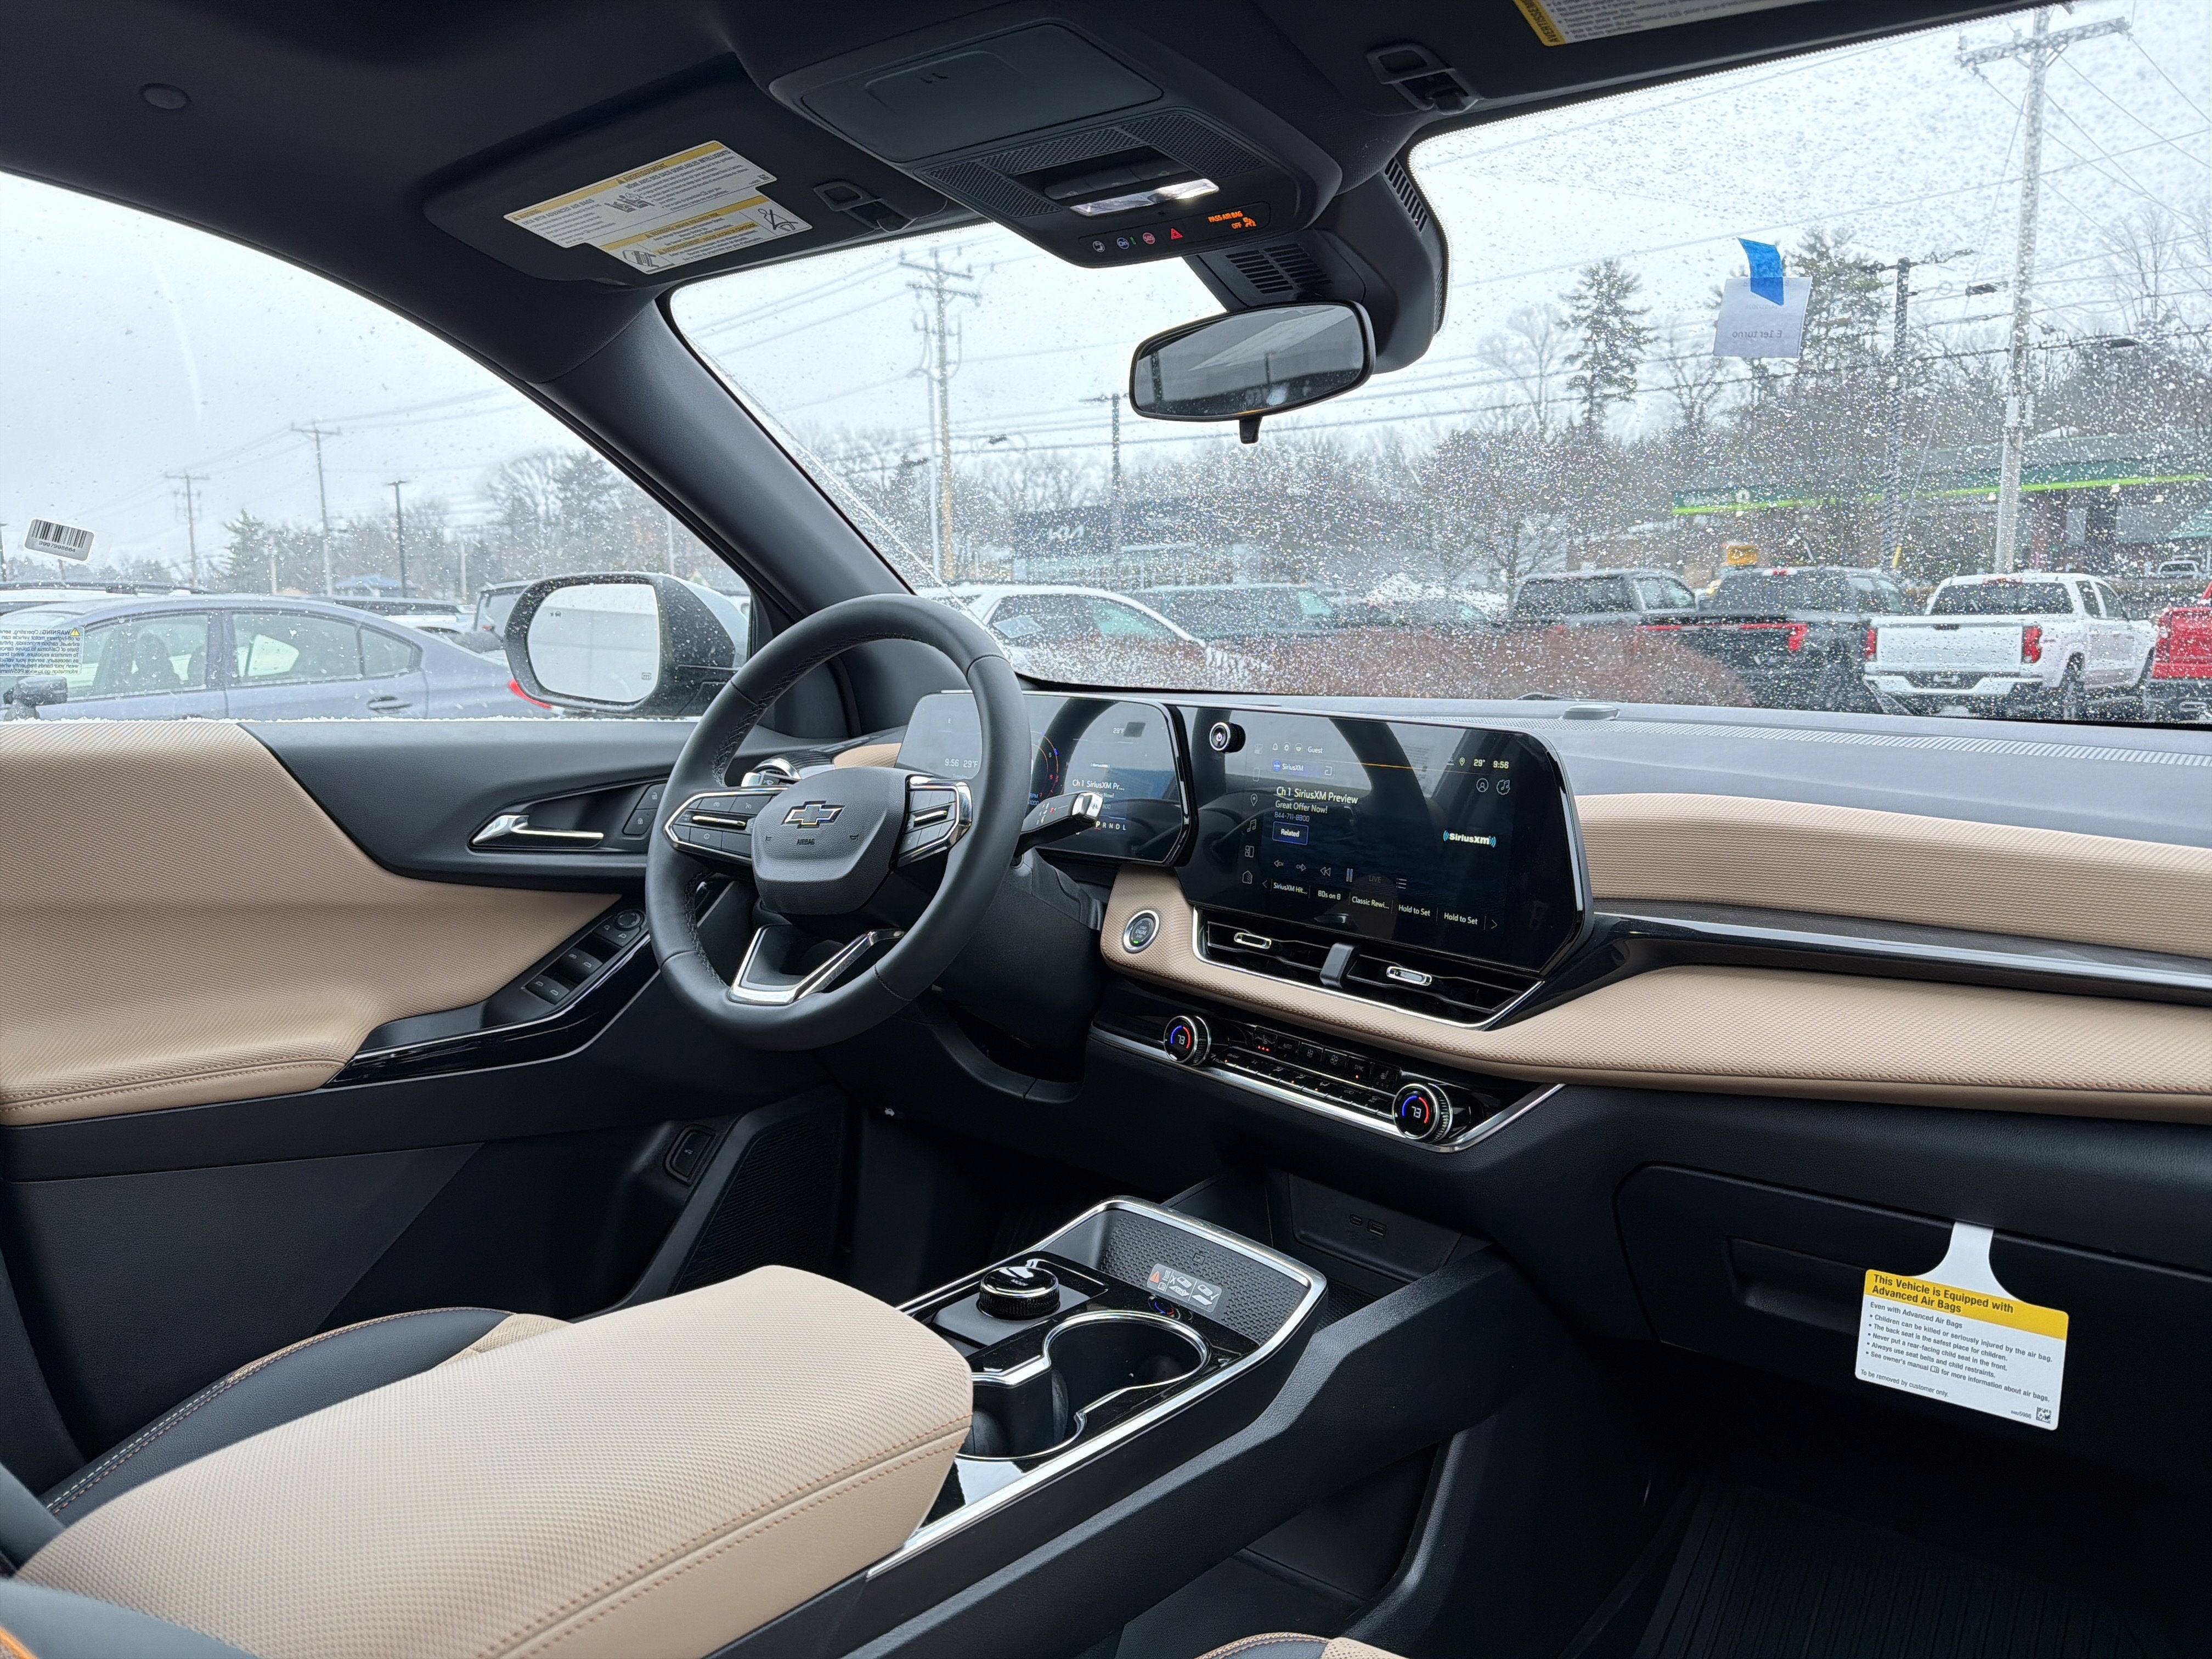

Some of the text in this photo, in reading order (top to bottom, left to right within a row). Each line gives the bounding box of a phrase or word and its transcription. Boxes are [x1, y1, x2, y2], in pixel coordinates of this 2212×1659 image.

[1231, 210, 1243, 219] BAG
[1143, 234, 1154, 243] SOS
[1307, 746, 1323, 754] Guest
[944, 758, 960, 767] 9:56
[1282, 763, 1304, 771] SiriusXM
[1474, 759, 1509, 769] 29° 9:56
[1086, 781, 1111, 789] SiriusXM
[1276, 786, 1358, 804] Ch 1 SiriusXM Preview
[1275, 800, 1328, 814] Great Offer Now!
[1274, 811, 1310, 822] 844-711-8800
[1280, 828, 1300, 837] Related
[1369, 875, 1382, 883] LIVE
[1273, 882, 1295, 892] SiriusXM
[1318, 890, 1328, 899] 80s
[1352, 896, 1390, 910] Classic Rewi...
[1398, 904, 1412, 913] Hold
[1420, 909, 1431, 917] Set
[1444, 912, 1458, 922] Hold
[1467, 917, 1478, 925] Set
[1177, 1034, 1186, 1046] 73
[1355, 1064, 1364, 1072] SYNC
[1871, 1284, 1961, 1313] Advanced Air Bags
[1873, 1273, 2013, 1313] This Vehicle is Equipped with
[1870, 1300, 1962, 1329] Even with Advanced Air Bags
[1873, 1322, 1884, 1331] The
[1885, 1325, 1900, 1335] back
[1900, 1330, 1914, 1339] seat
[1921, 1334, 1932, 1342] the
[1932, 1338, 1951, 1347] safest
[1952, 1342, 1970, 1352] place
[1970, 1346, 1980, 1354] for
[1980, 1349, 2007, 1361] children.
[1874, 1313, 1900, 1325] Children
[1900, 1321, 1913, 1329] can
[1923, 1324, 1941, 1335] killed
[1950, 1333, 1980, 1345] seriously
[1980, 1339, 2004, 1350] injured
[2005, 1345, 2013, 1353] by
[2015, 1347, 2026, 1356] the
[2038, 1352, 2052, 1363] bag.
[1872, 1332, 1890, 1342] Never
[1906, 1341, 1940, 1356] rear-facing
[1940, 1349, 1956, 1358] child
[1957, 1353, 1971, 1362] seat
[1971, 1356, 1978, 1364] in
[1979, 1358, 1990, 1367] the
[1990, 1361, 2007, 1372] front.
[1870, 1341, 1893, 1352] Always
[1905, 1351, 1918, 1359] seat
[1919, 1353, 1934, 1363] belts
[1935, 1358, 1948, 1366] and
[1948, 1361, 1963, 1370] child
[1964, 1365, 1996, 1378] restraints.
[1870, 1350, 1882, 1359] See
[1882, 1355, 1906, 1365] owner's
[1906, 1361, 1929, 1370] manual
[1940, 1368, 1950, 1376] for
[1950, 1372, 1967, 1380] more
[1967, 1374, 2002, 1390] information
[2003, 1385, 2022, 1395] about
[2032, 1391, 2050, 1402] bags.
[1860, 1367, 1949, 1398] To be removed by customer only.
